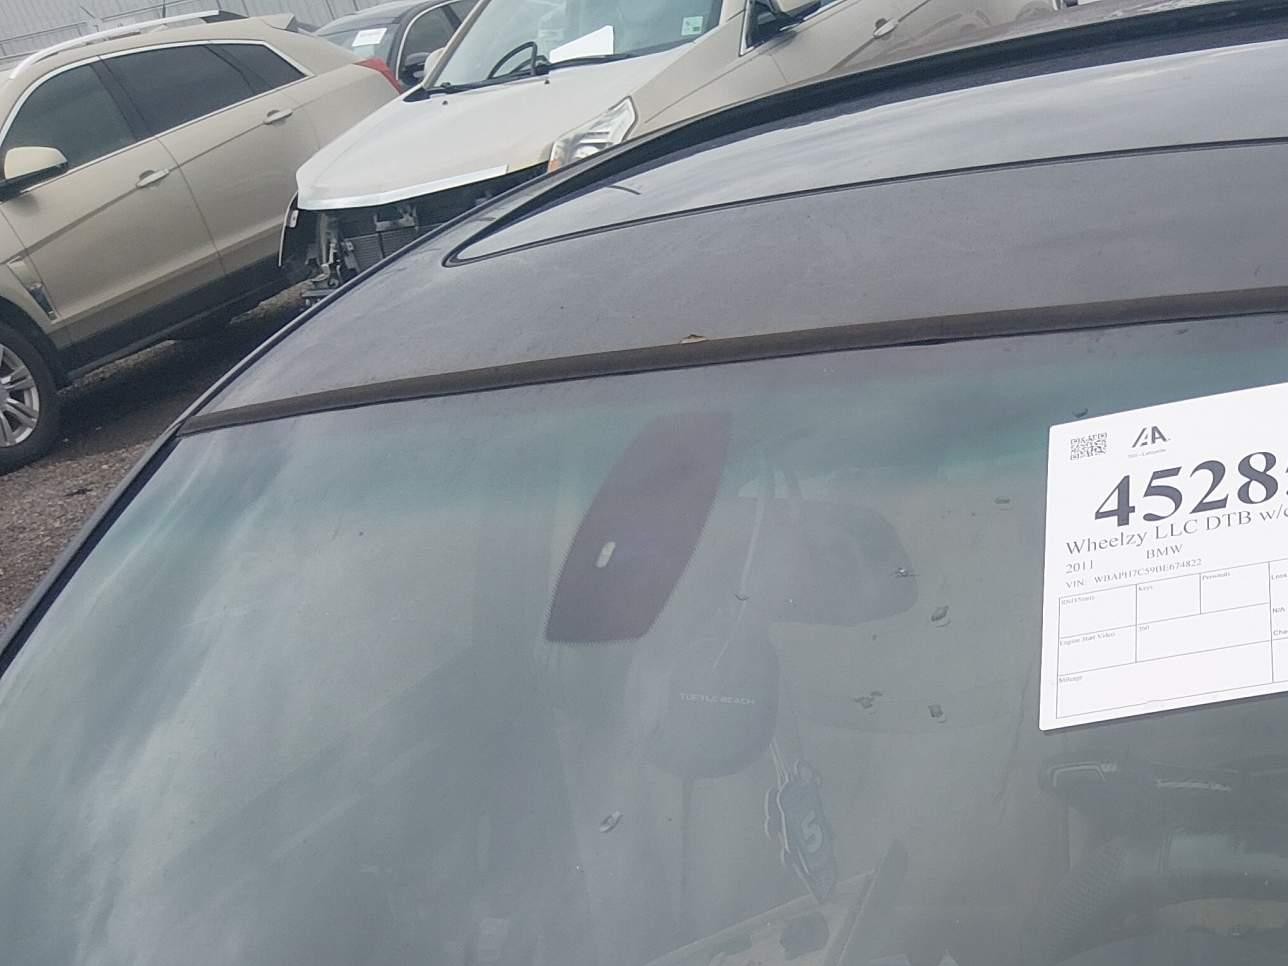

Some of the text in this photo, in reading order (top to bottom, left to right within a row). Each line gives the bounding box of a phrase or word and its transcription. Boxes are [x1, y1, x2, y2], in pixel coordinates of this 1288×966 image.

[1066, 531, 1148, 556] Wheelzy
[1155, 519, 1199, 540] LLC
[1206, 510, 1251, 531] DTB
[1066, 560, 1093, 574] 2011
[1146, 543, 1183, 559] BMW
